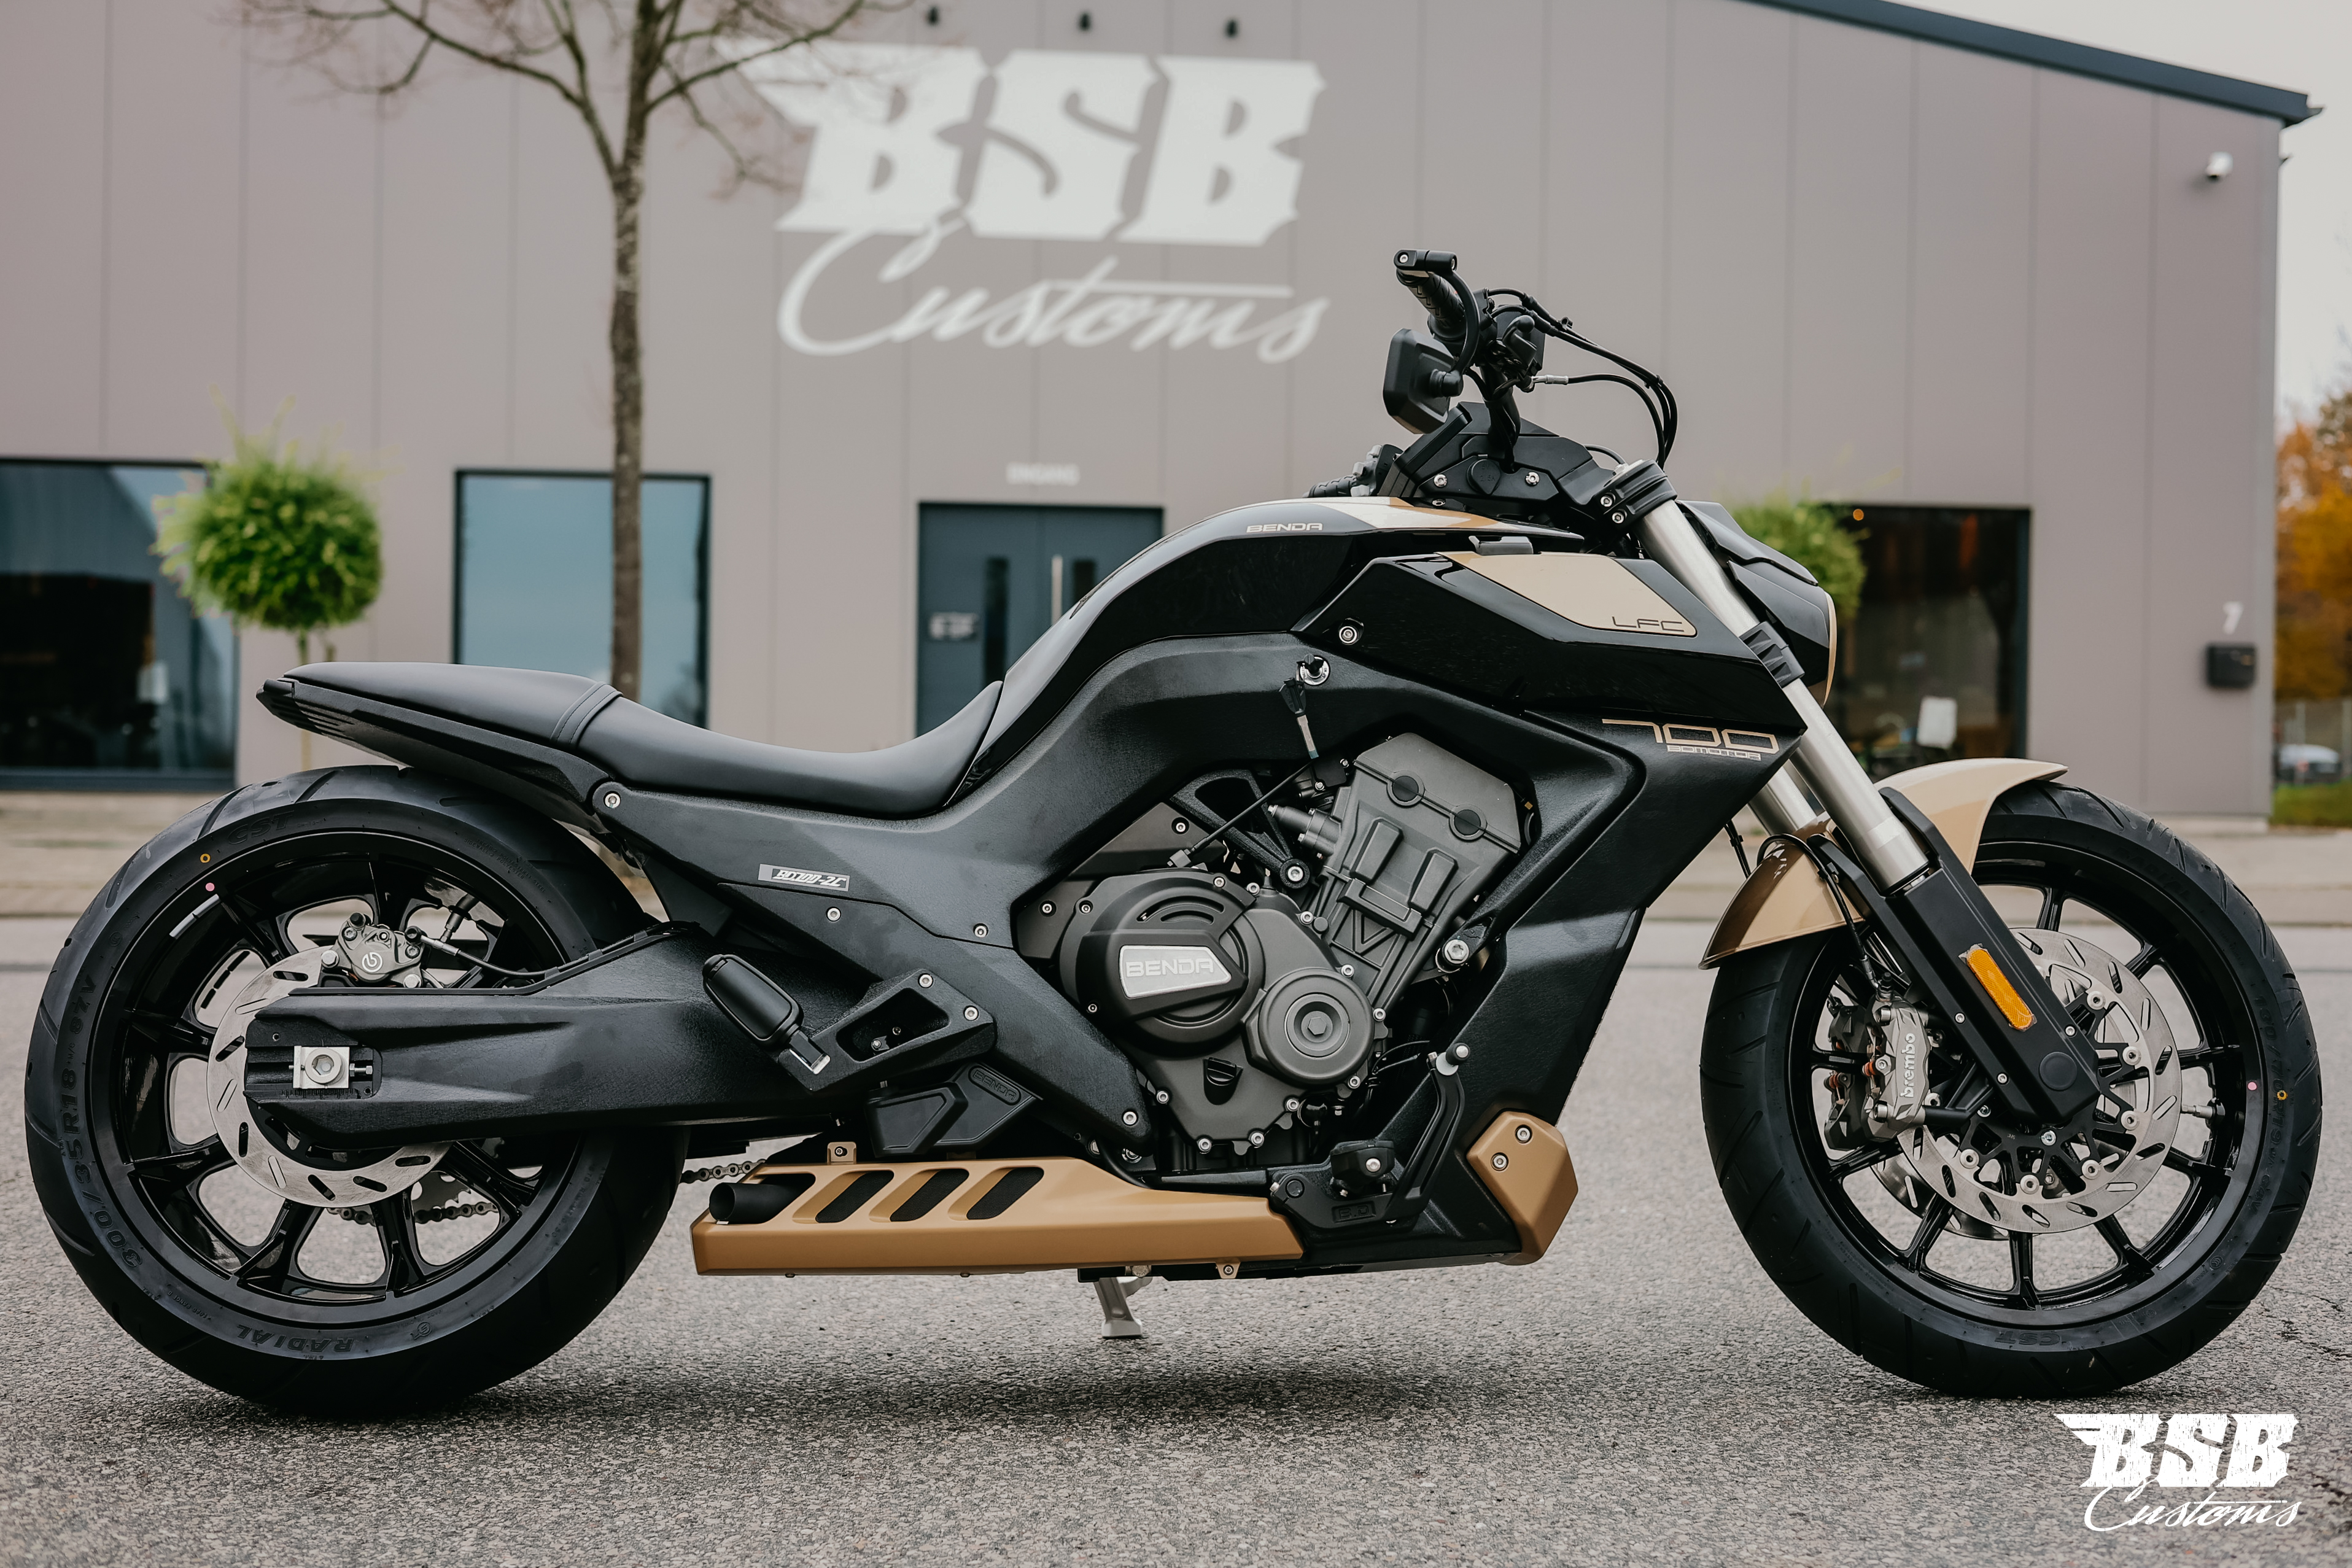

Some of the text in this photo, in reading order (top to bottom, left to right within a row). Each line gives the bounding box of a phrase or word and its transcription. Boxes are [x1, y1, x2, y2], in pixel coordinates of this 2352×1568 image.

[711, 42, 1326, 247] BSB
[777, 219, 1330, 363] Customs
[1246, 522, 1323, 533] BENDA
[1612, 616, 1685, 632] LFC
[1602, 718, 1779, 755] 700
[1667, 745, 1761, 761] BDMOTOR
[228, 810, 295, 845] CST
[1126, 958, 1214, 977] BENDA
[69, 974, 96, 1034] 87V
[1900, 1033, 1916, 1098] brembo
[973, 1070, 1017, 1101] BENDA
[61, 1068, 143, 1267] 300/35R18
[236, 1324, 354, 1353] RADIAL
[1994, 1331, 2062, 1346] CST
